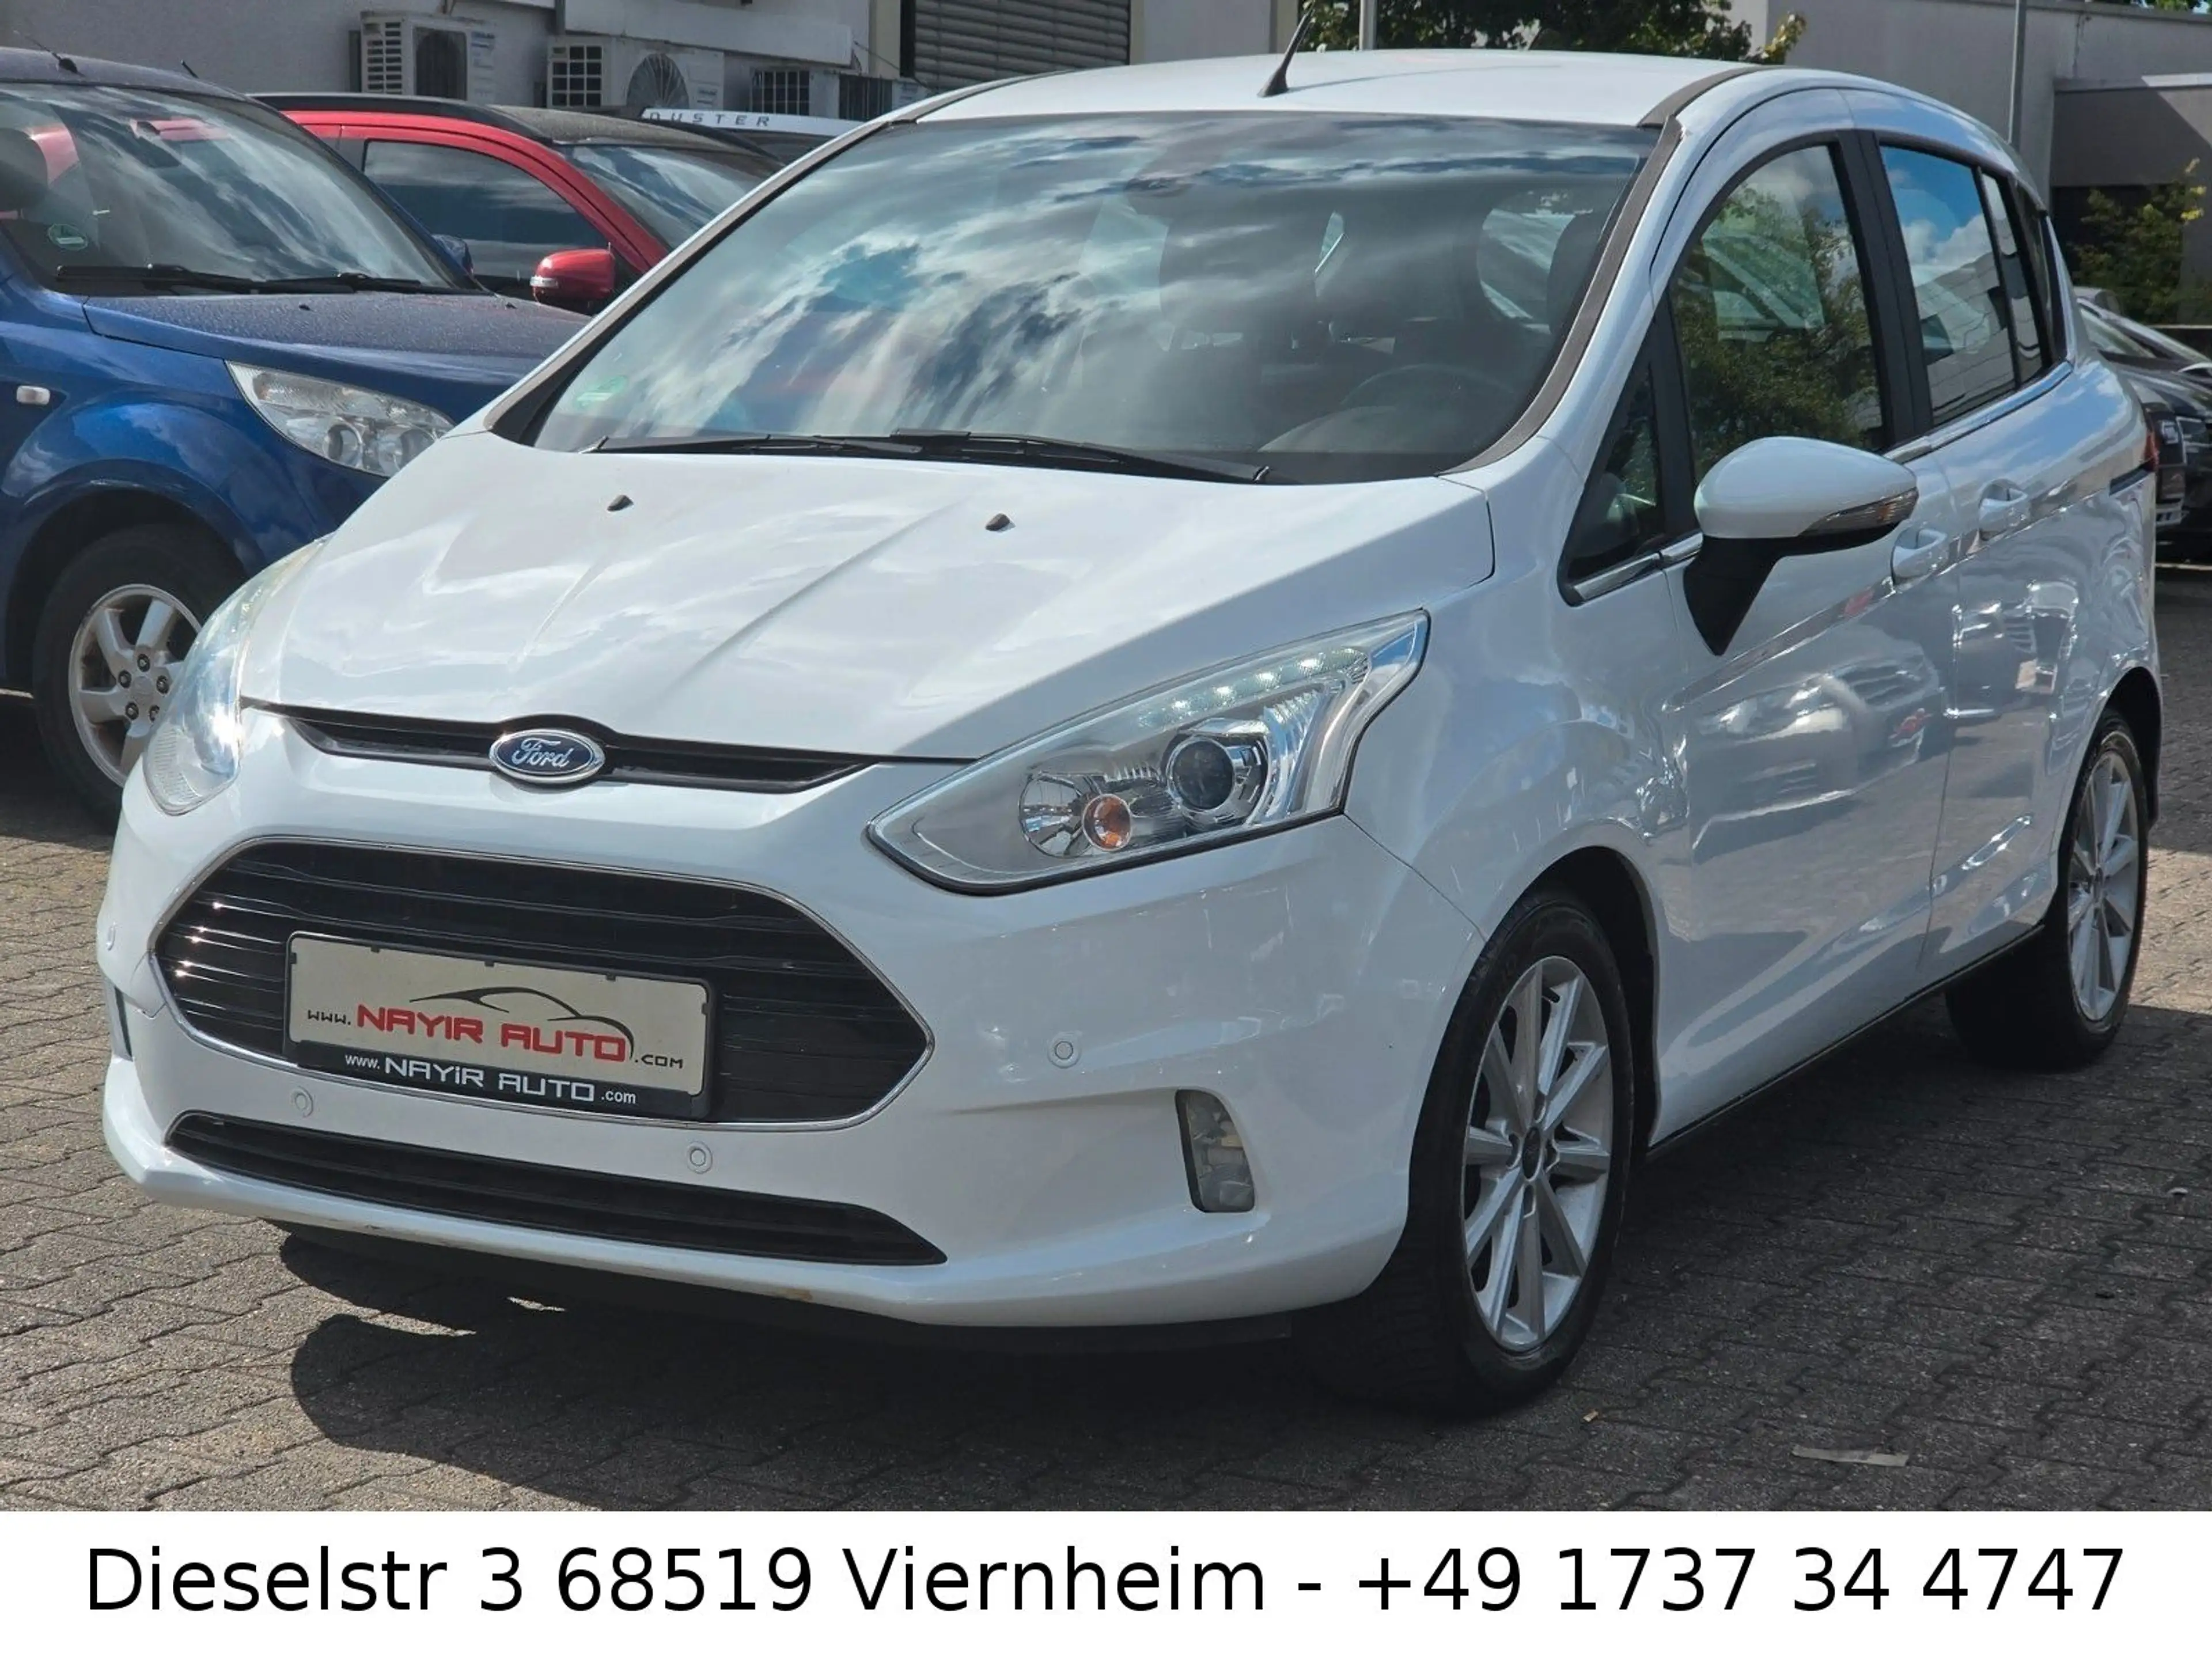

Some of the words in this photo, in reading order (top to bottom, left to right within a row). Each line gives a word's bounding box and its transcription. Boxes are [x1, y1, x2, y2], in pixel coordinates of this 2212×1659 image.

[649, 111, 770, 127] DUSTER
[511, 737, 574, 767] Ford
[357, 1004, 484, 1044] NAYIR
[501, 1023, 626, 1062] AUTO
[498, 1073, 595, 1102] AUTO
